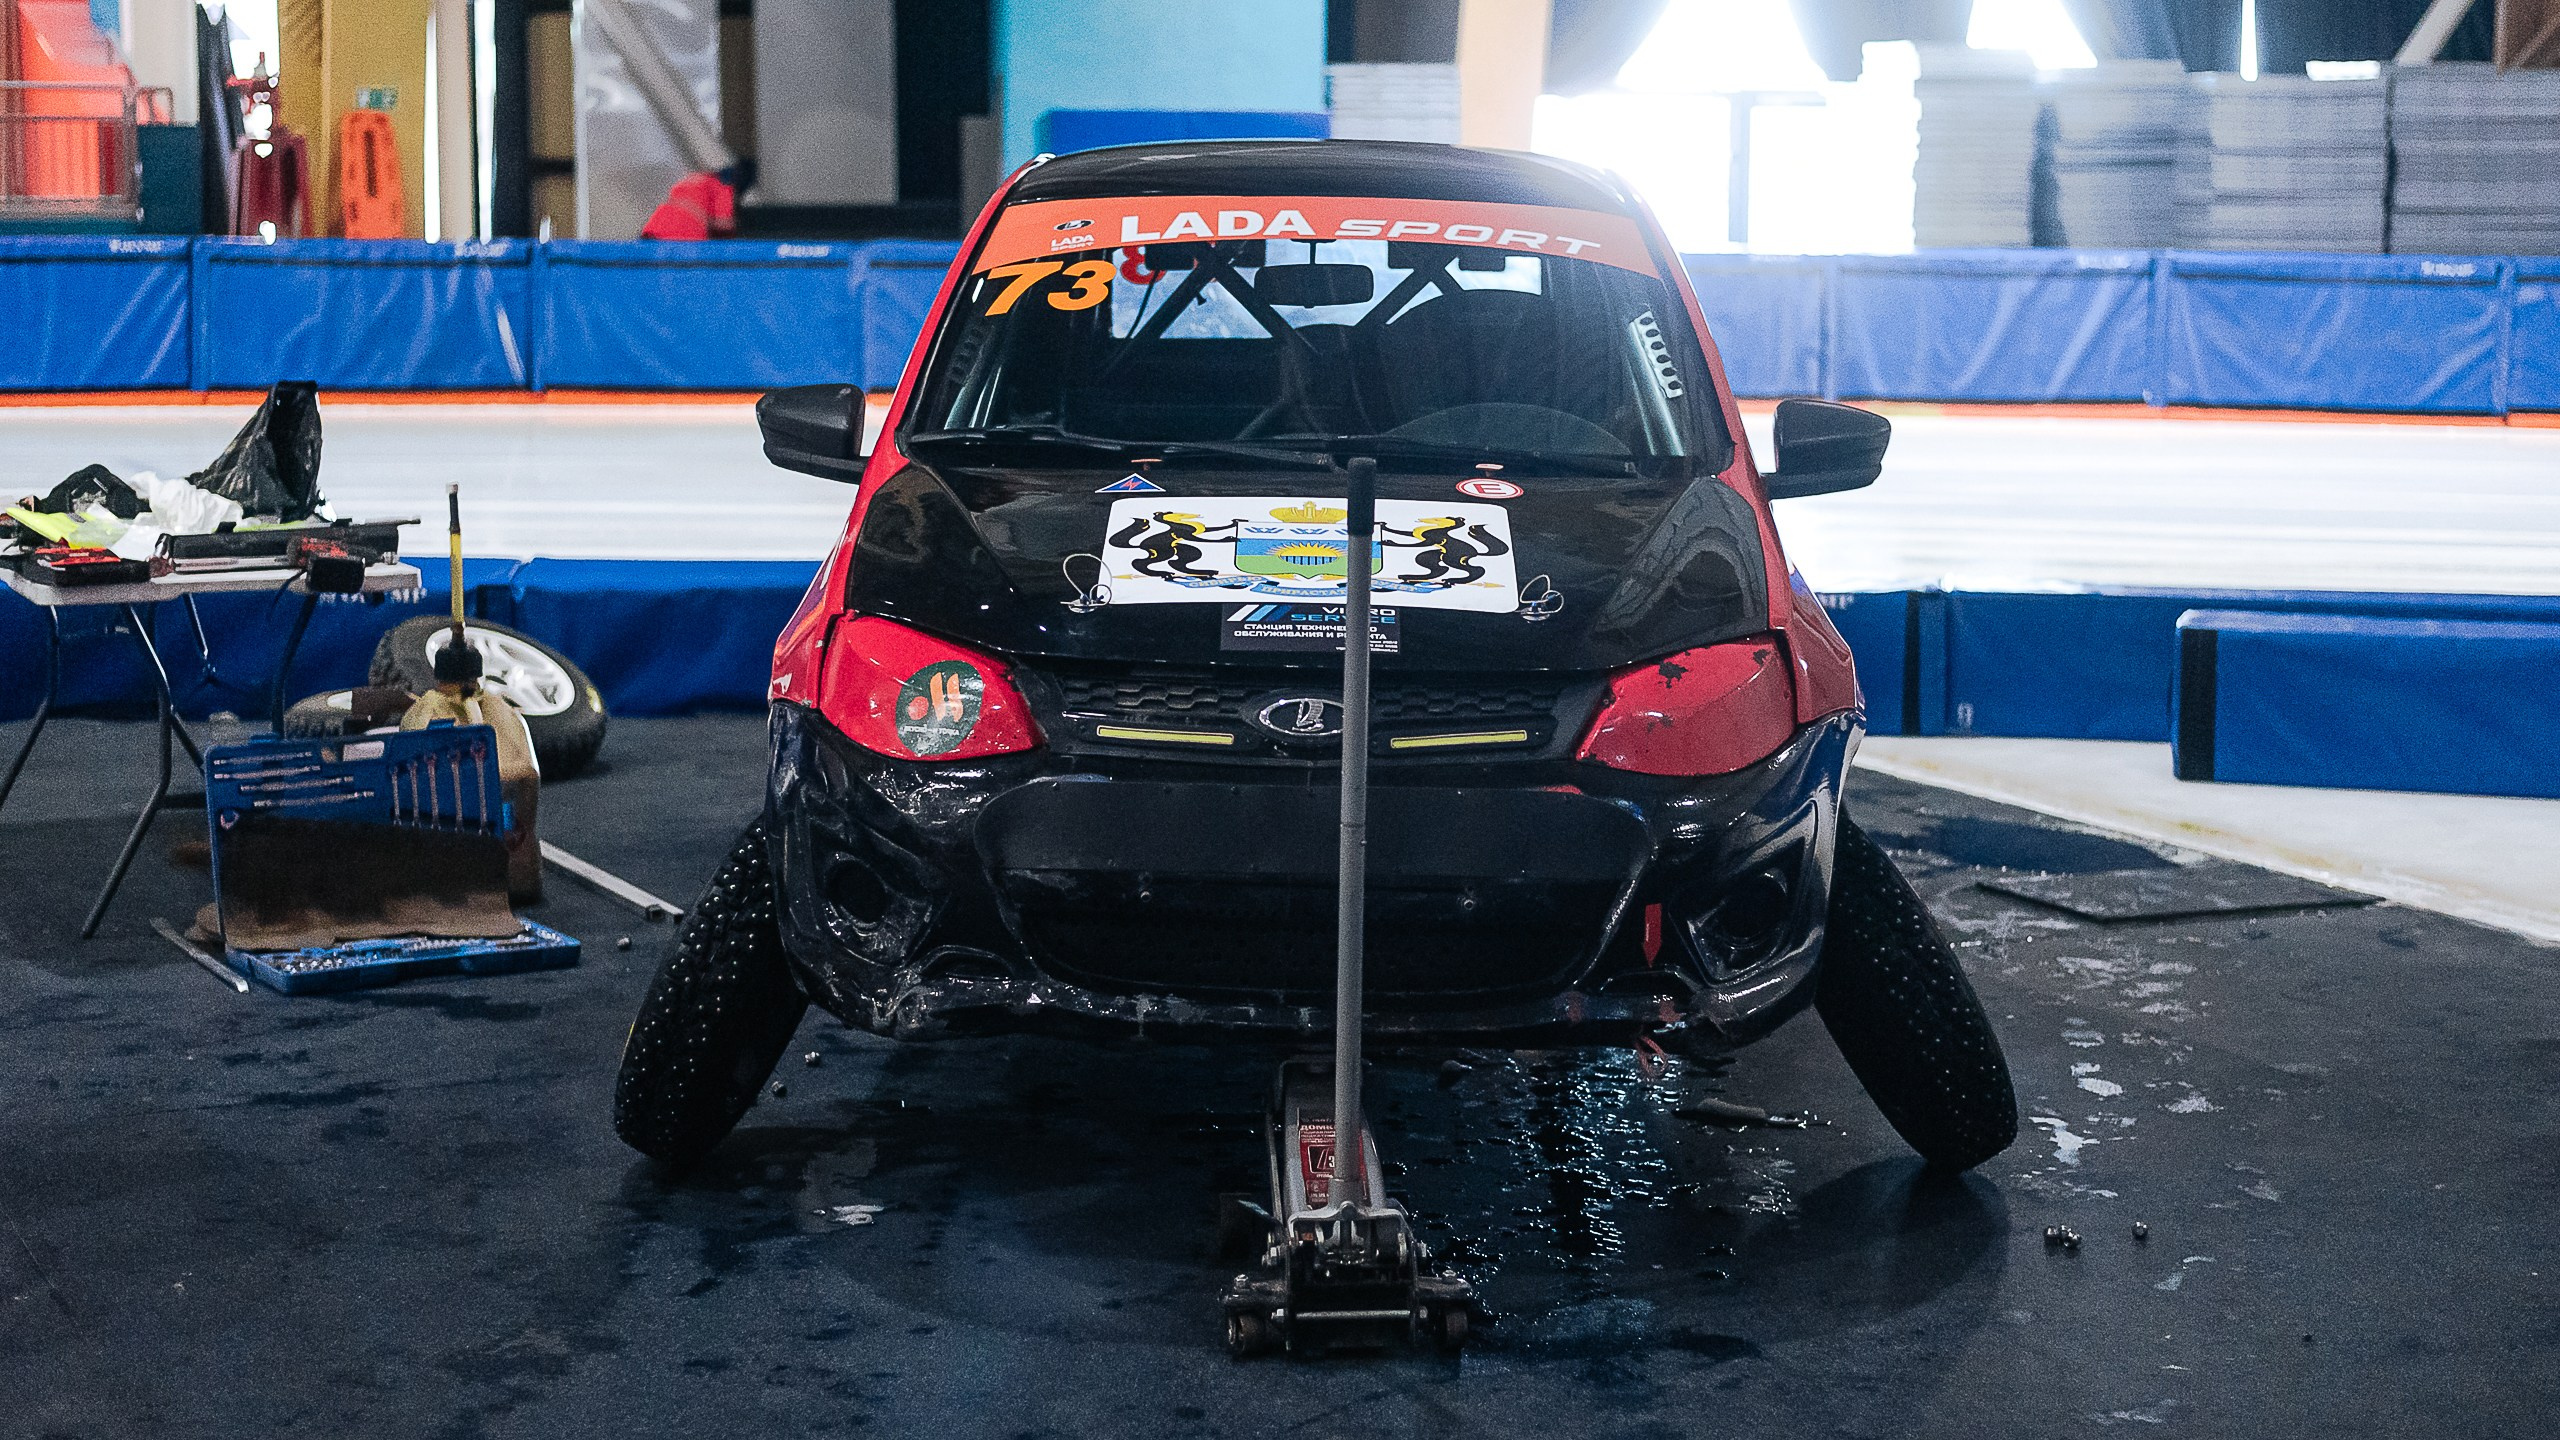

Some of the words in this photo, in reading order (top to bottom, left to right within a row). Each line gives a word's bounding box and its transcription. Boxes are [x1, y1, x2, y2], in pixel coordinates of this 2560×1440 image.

[1121, 209, 1317, 243] LADA
[1335, 219, 1601, 255] SPORT
[1051, 234, 1095, 248] LADA
[985, 260, 1117, 316] 73
[1234, 630, 1324, 639] ОБСЛУЖИВАНИЯ
[1243, 624, 1293, 632] СТАНЦИЯ
